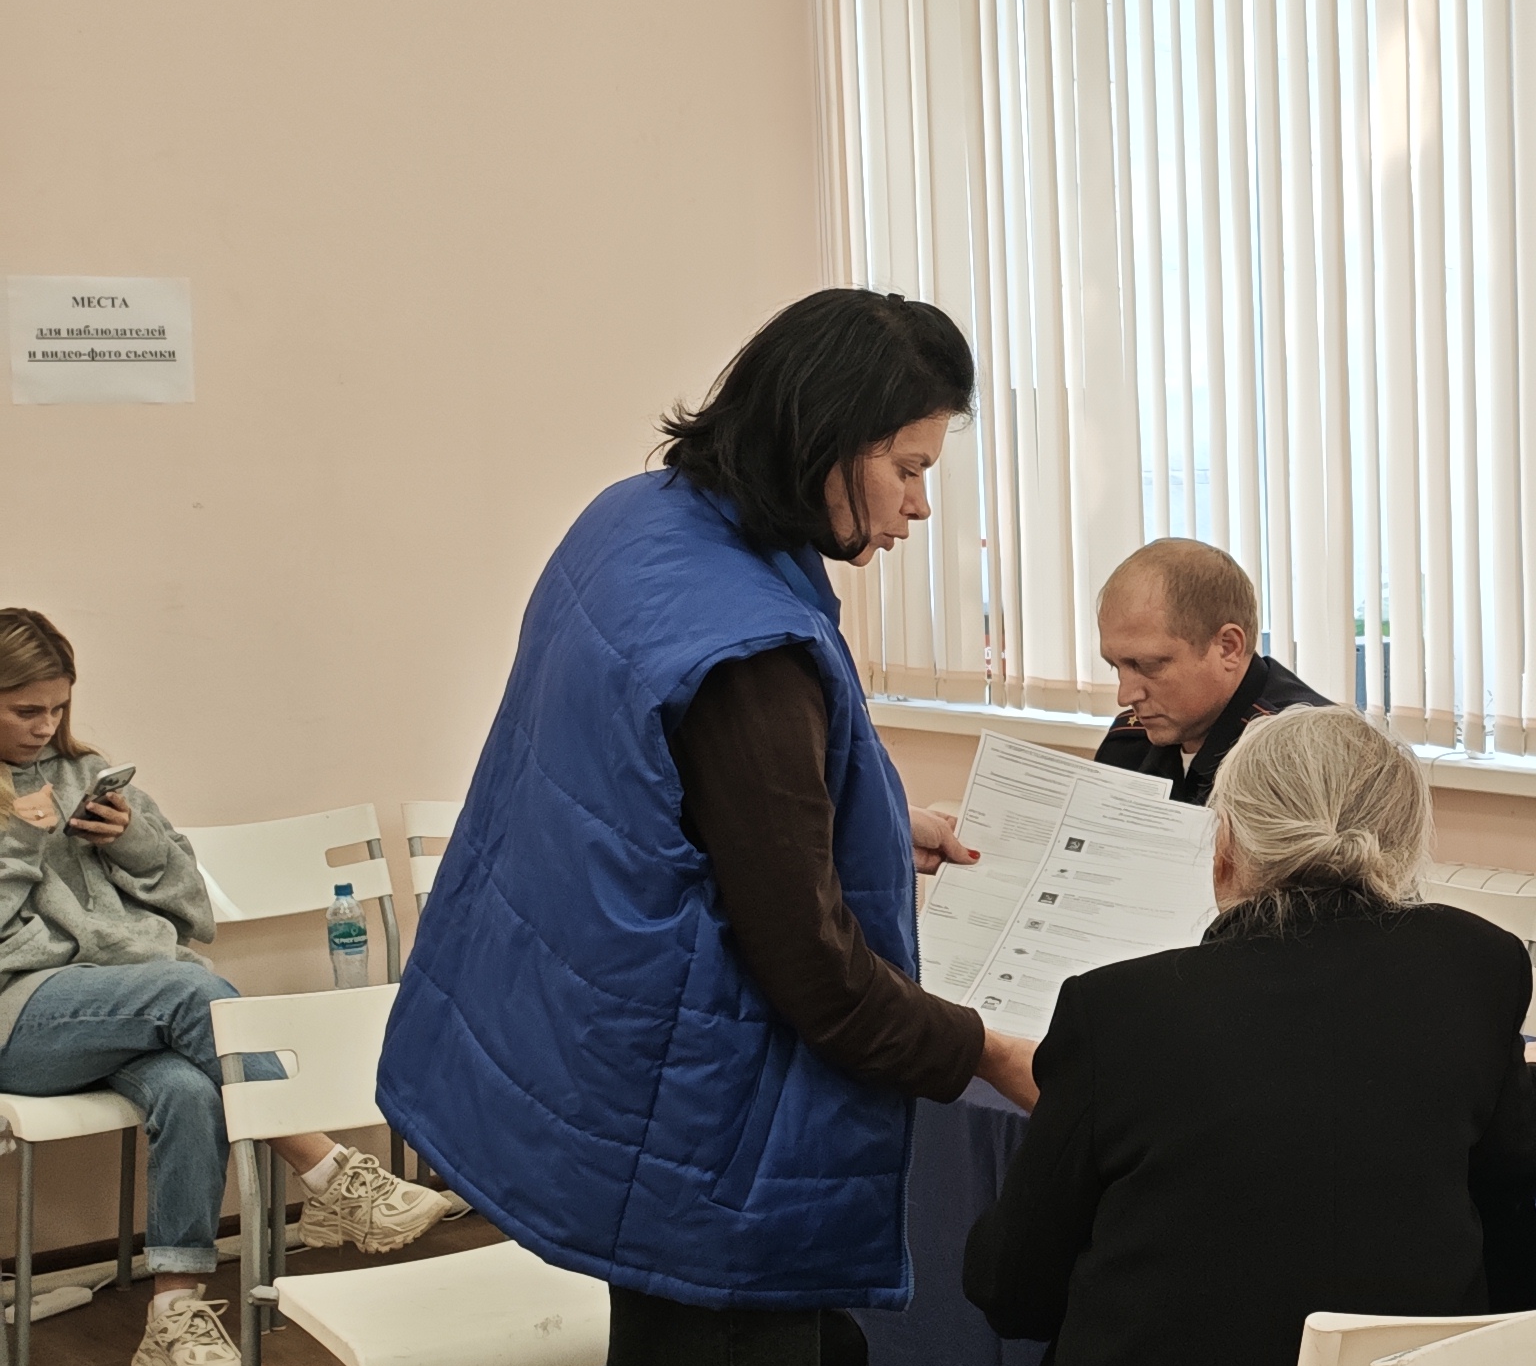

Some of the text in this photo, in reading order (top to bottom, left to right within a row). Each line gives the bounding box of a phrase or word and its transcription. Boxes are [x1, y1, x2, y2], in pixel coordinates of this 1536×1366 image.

[72, 296, 130, 308] МЕСТА
[36, 325, 166, 338] для наблюдателей
[28, 350, 37, 359] и
[125, 349, 176, 360] съемки
